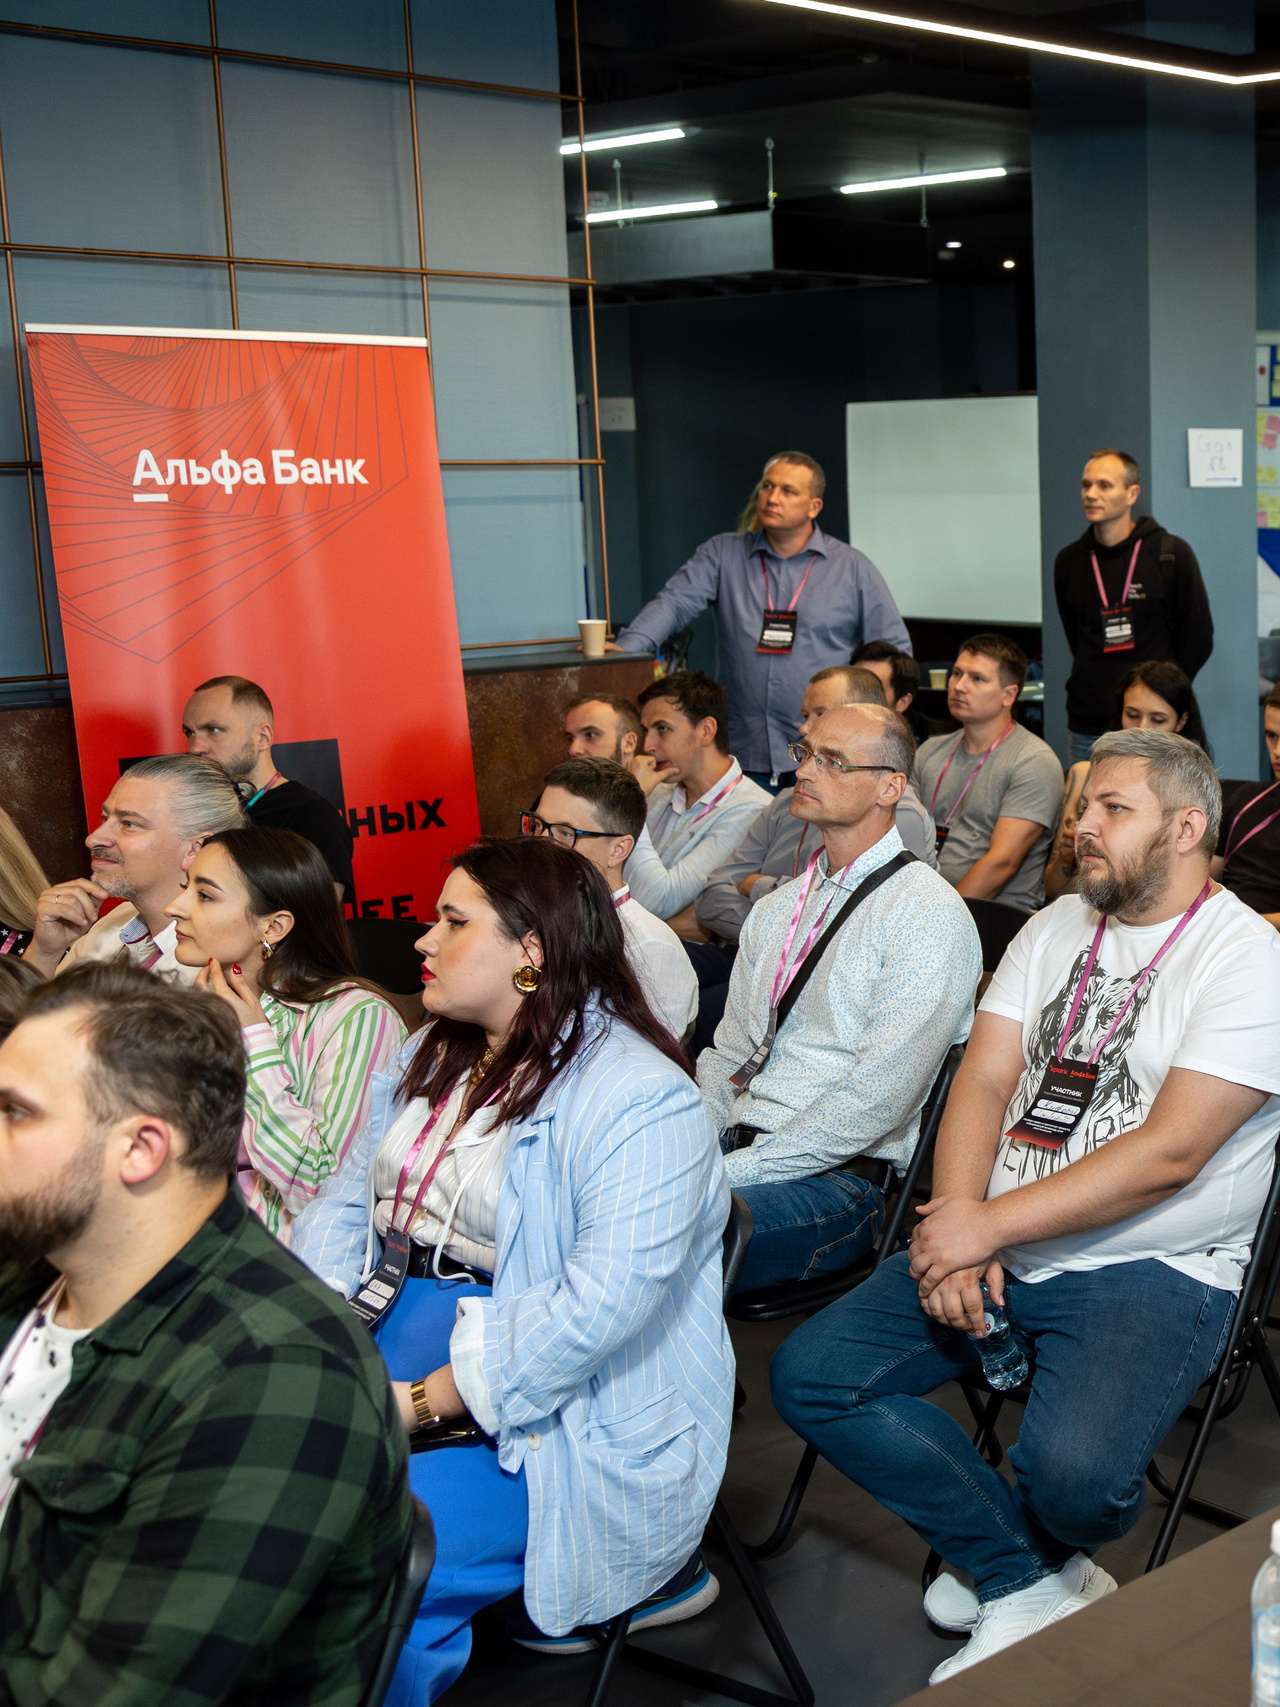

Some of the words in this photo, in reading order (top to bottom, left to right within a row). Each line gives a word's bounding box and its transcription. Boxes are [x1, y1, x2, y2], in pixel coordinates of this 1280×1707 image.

[132, 448, 266, 496] Альфа
[271, 448, 369, 485] Банк
[1050, 1085, 1083, 1098] УЧАСТНИК
